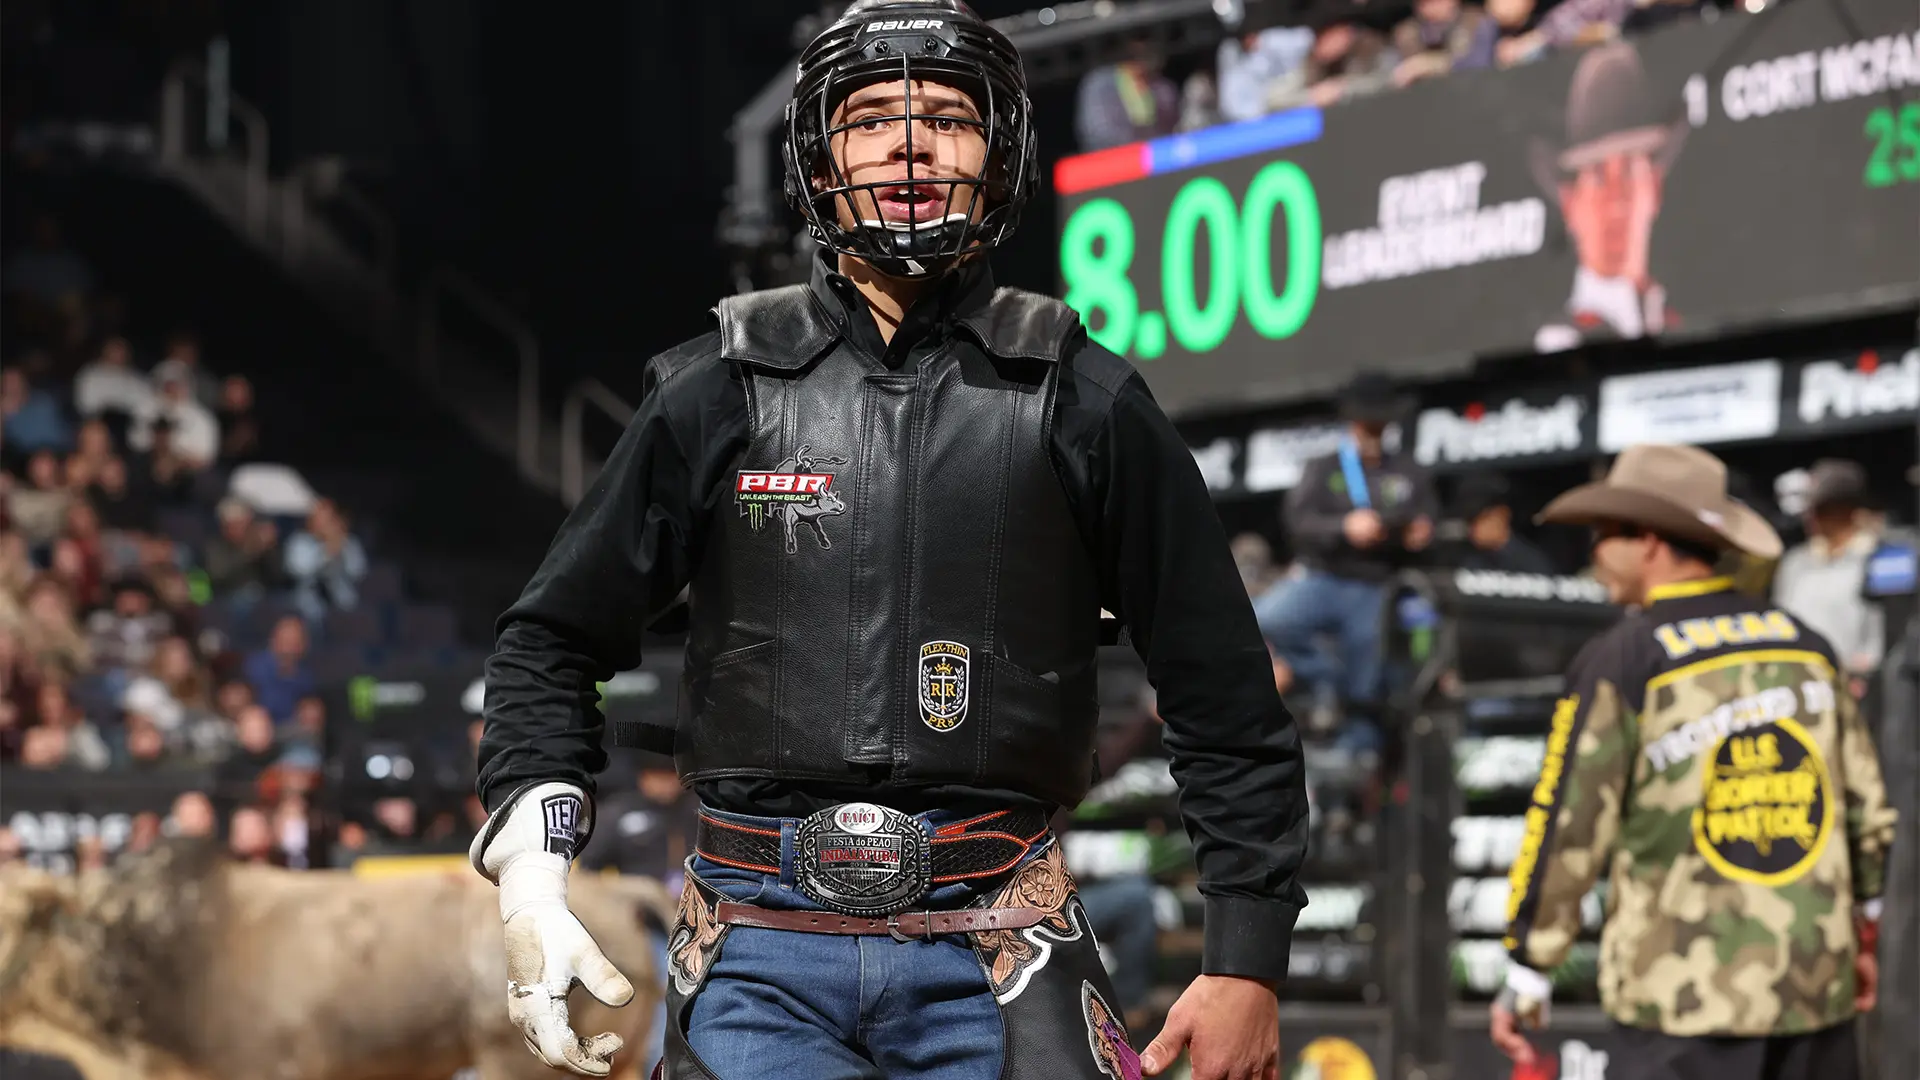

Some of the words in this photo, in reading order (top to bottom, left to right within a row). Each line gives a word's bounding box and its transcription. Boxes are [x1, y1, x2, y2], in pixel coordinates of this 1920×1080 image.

[866, 20, 943, 33] BAUER
[1322, 197, 1546, 289] LEADERBOARD
[1060, 197, 1322, 361] 8.00
[741, 474, 827, 491] PBR
[784, 494, 812, 502] BEAST
[1654, 610, 1799, 660] LUCAS
[923, 643, 968, 657] FLEX-THIN
[1707, 771, 1818, 812] BORDER
[1706, 805, 1817, 844] PATROL
[827, 837, 854, 847] FESTA
[855, 838, 866, 847] do
[820, 848, 899, 863] INDAIATUBA
